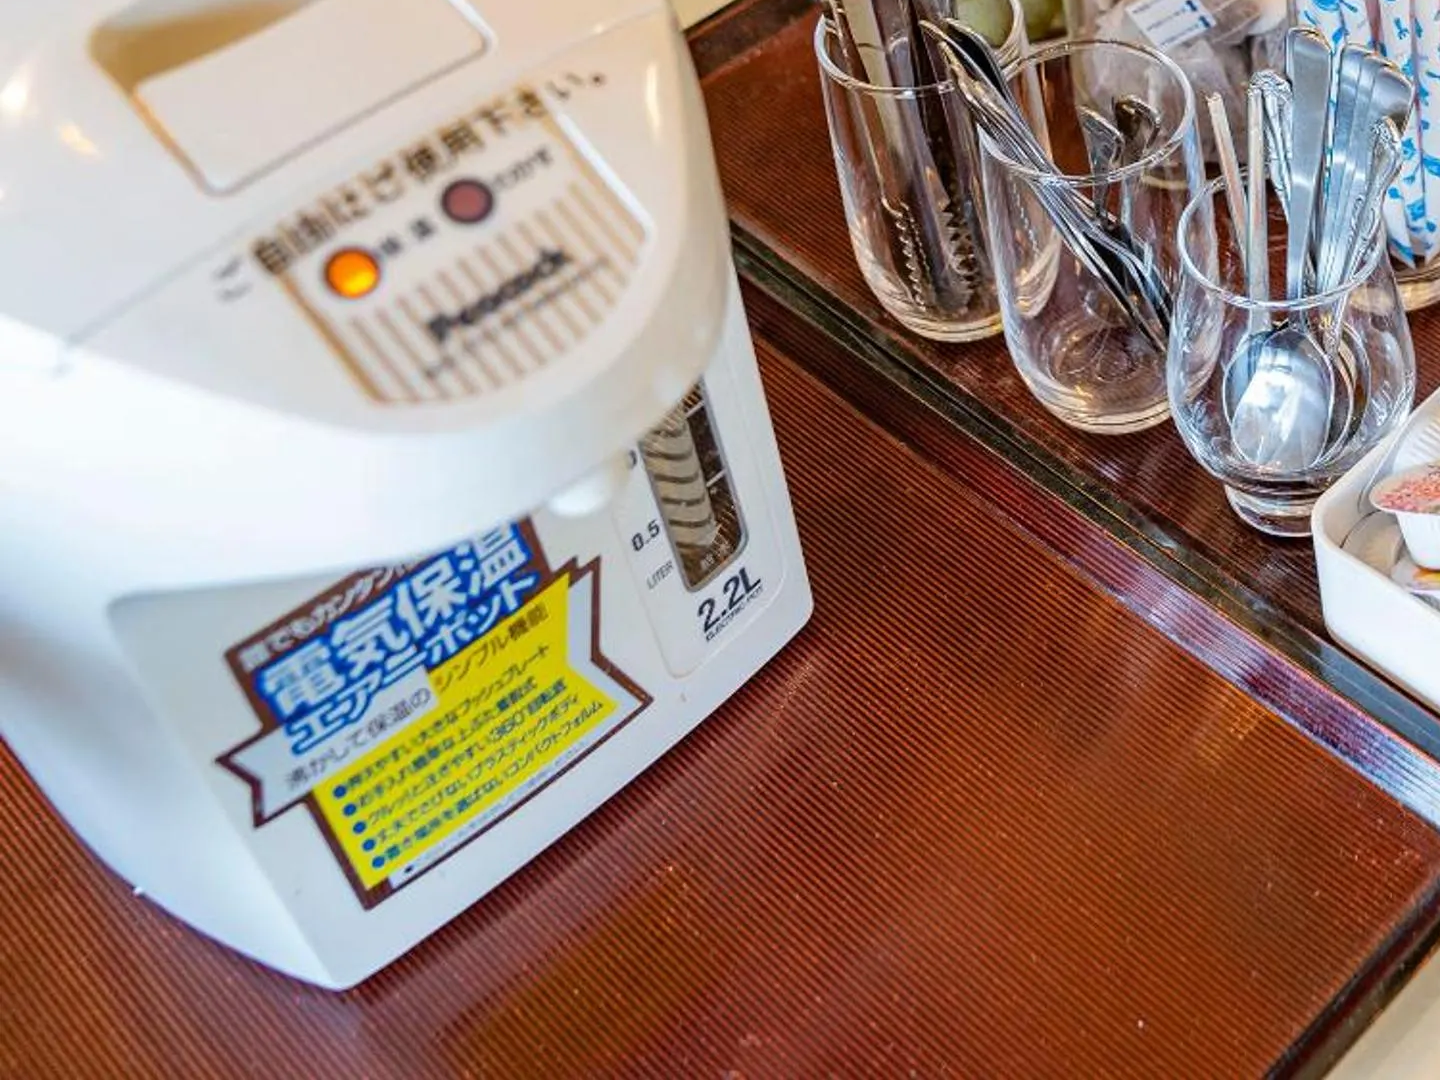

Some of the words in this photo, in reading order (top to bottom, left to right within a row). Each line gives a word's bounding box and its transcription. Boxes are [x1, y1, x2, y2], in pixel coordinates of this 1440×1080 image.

[631, 519, 660, 552] 0.5
[263, 521, 531, 716] 電気保温
[697, 567, 761, 634] 2.2L
